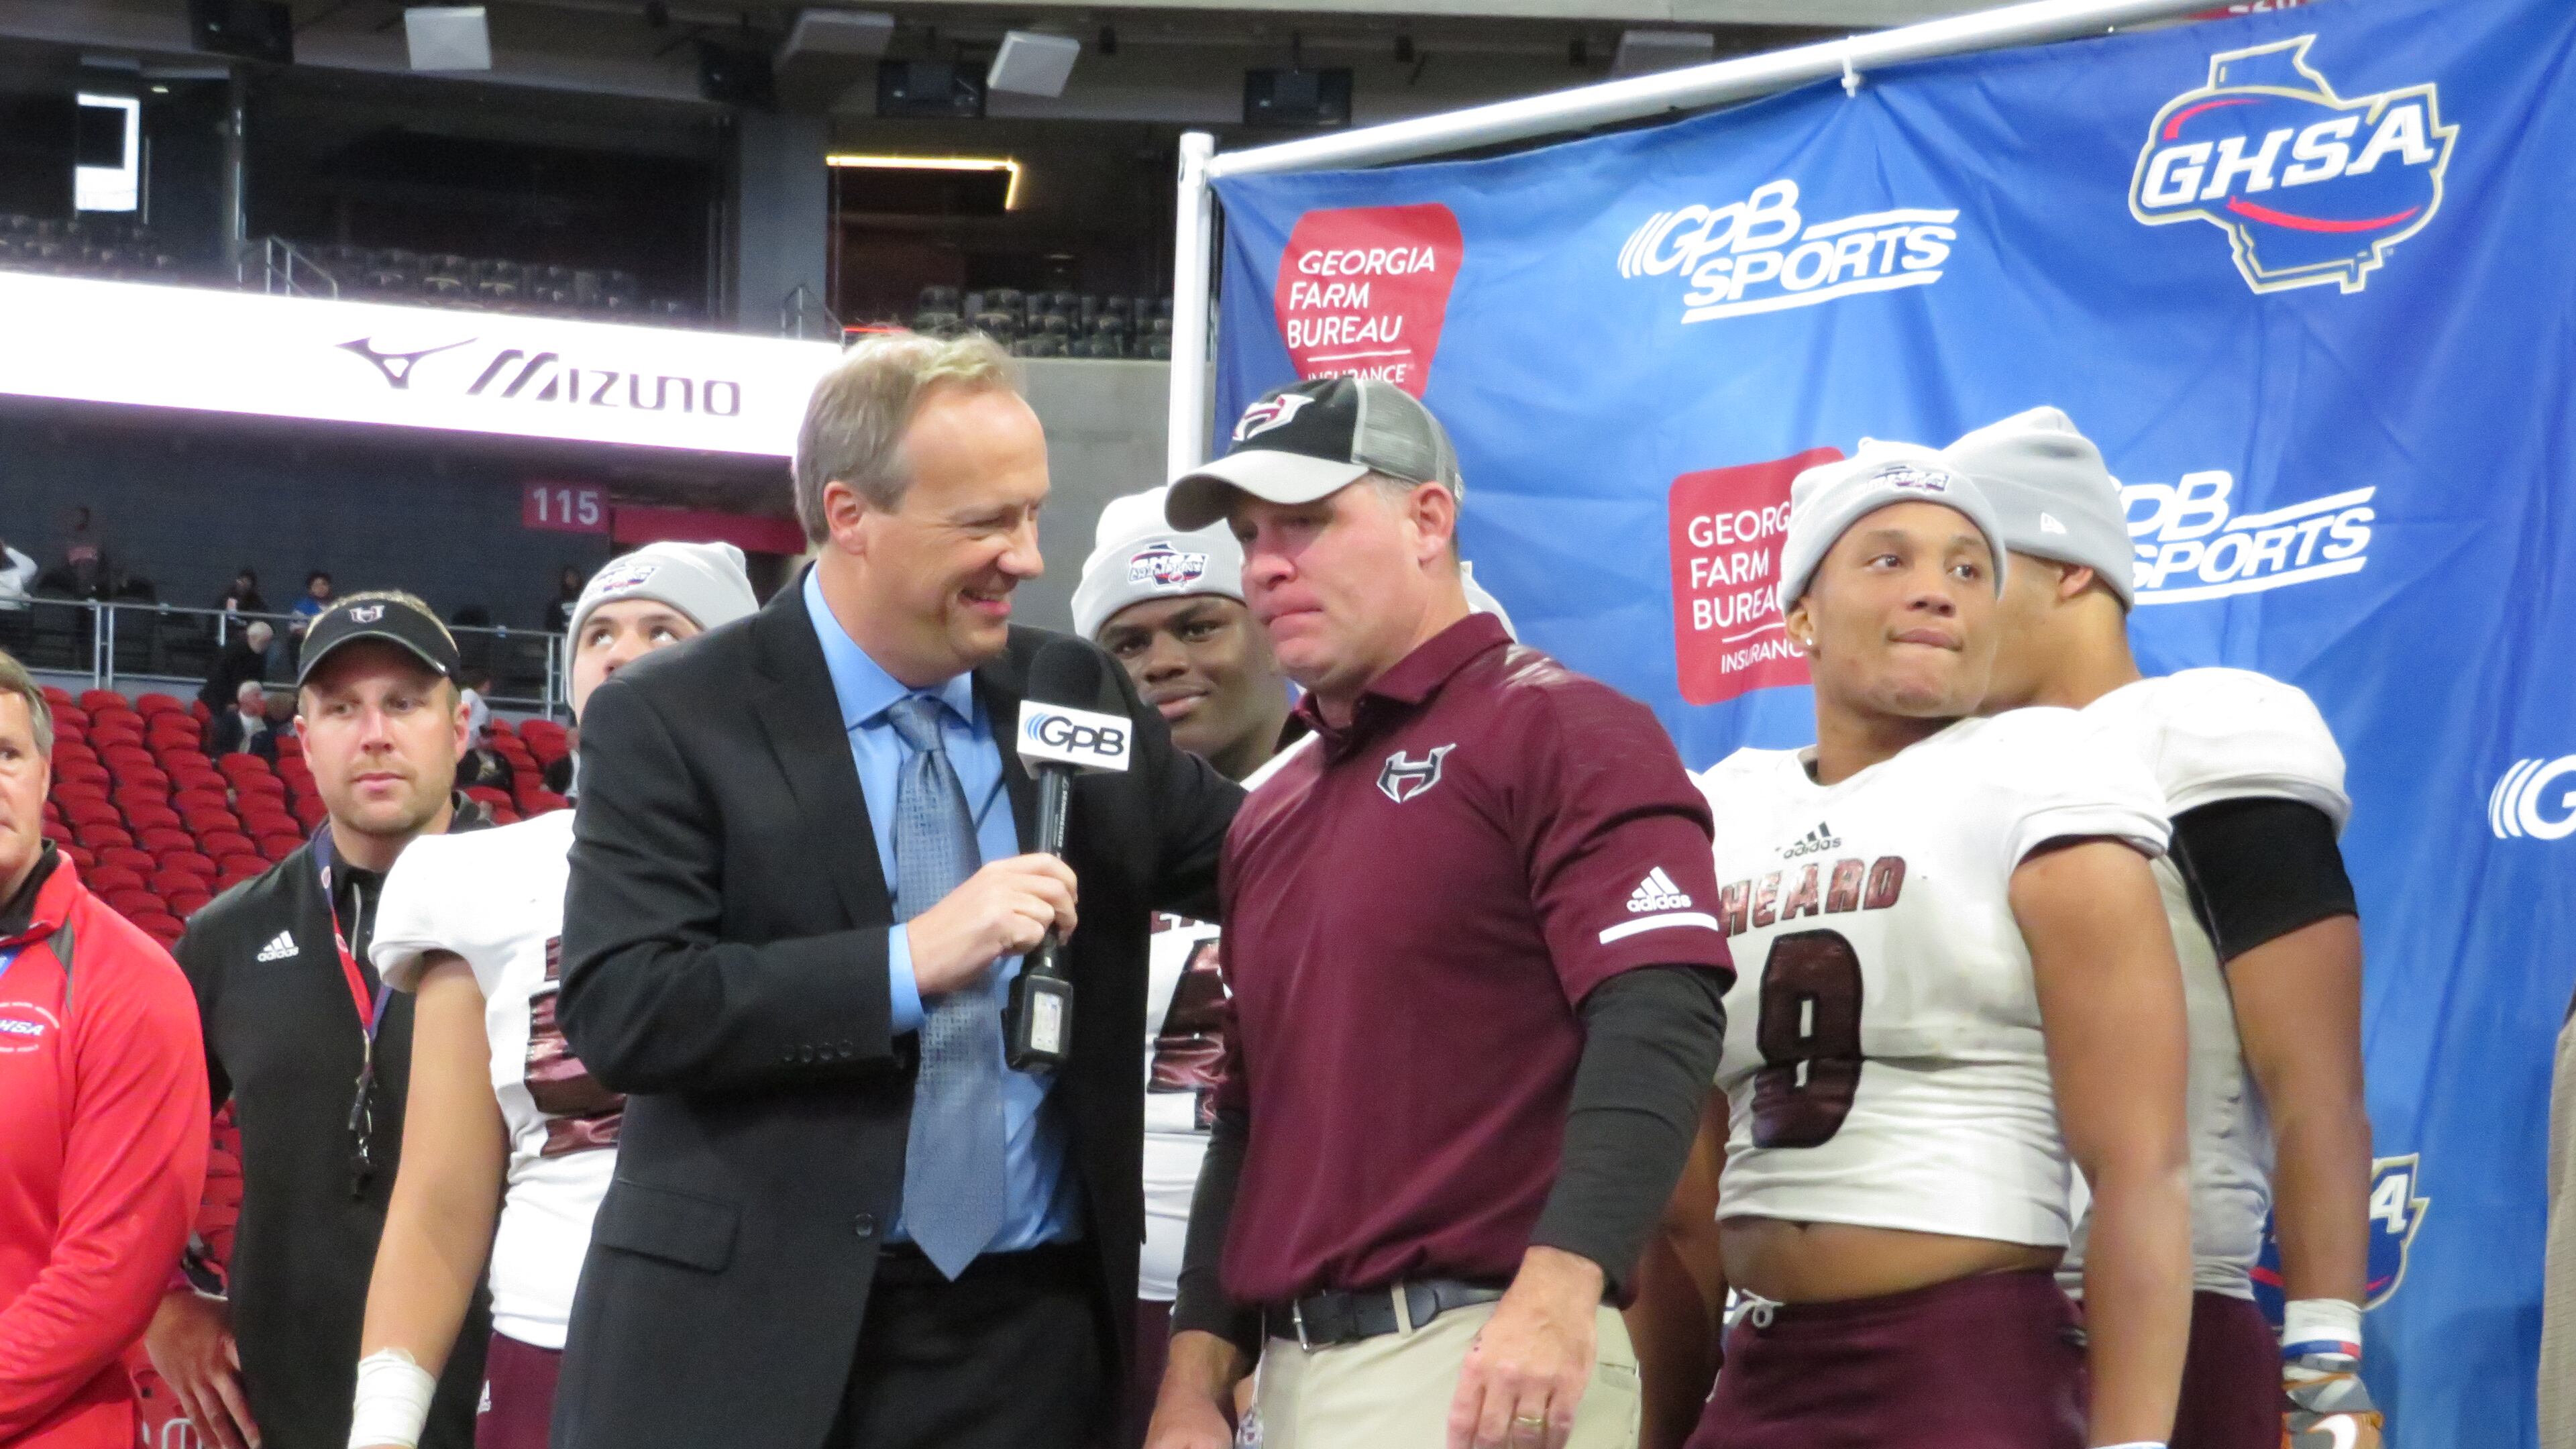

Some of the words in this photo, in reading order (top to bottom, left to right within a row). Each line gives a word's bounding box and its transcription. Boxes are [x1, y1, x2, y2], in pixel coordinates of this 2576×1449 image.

[2141, 104, 2434, 208] GHSA
[1298, 246, 1435, 276] GEORGIA
[1684, 225, 1957, 307] SPORTS
[1289, 282, 1370, 310] FARM
[1287, 315, 1402, 349] BUREAU
[533, 486, 599, 526] 115
[1688, 501, 1790, 548] GEORG
[2109, 470, 2233, 541] PB
[1690, 547, 1770, 589] FARM
[2132, 506, 2375, 589] SPORTS
[1783, 837, 1841, 859] adidas
[1626, 893, 1692, 913] adidas
[1720, 855, 1906, 938] HEARD
[0, 1019, 45, 1037] HSA
